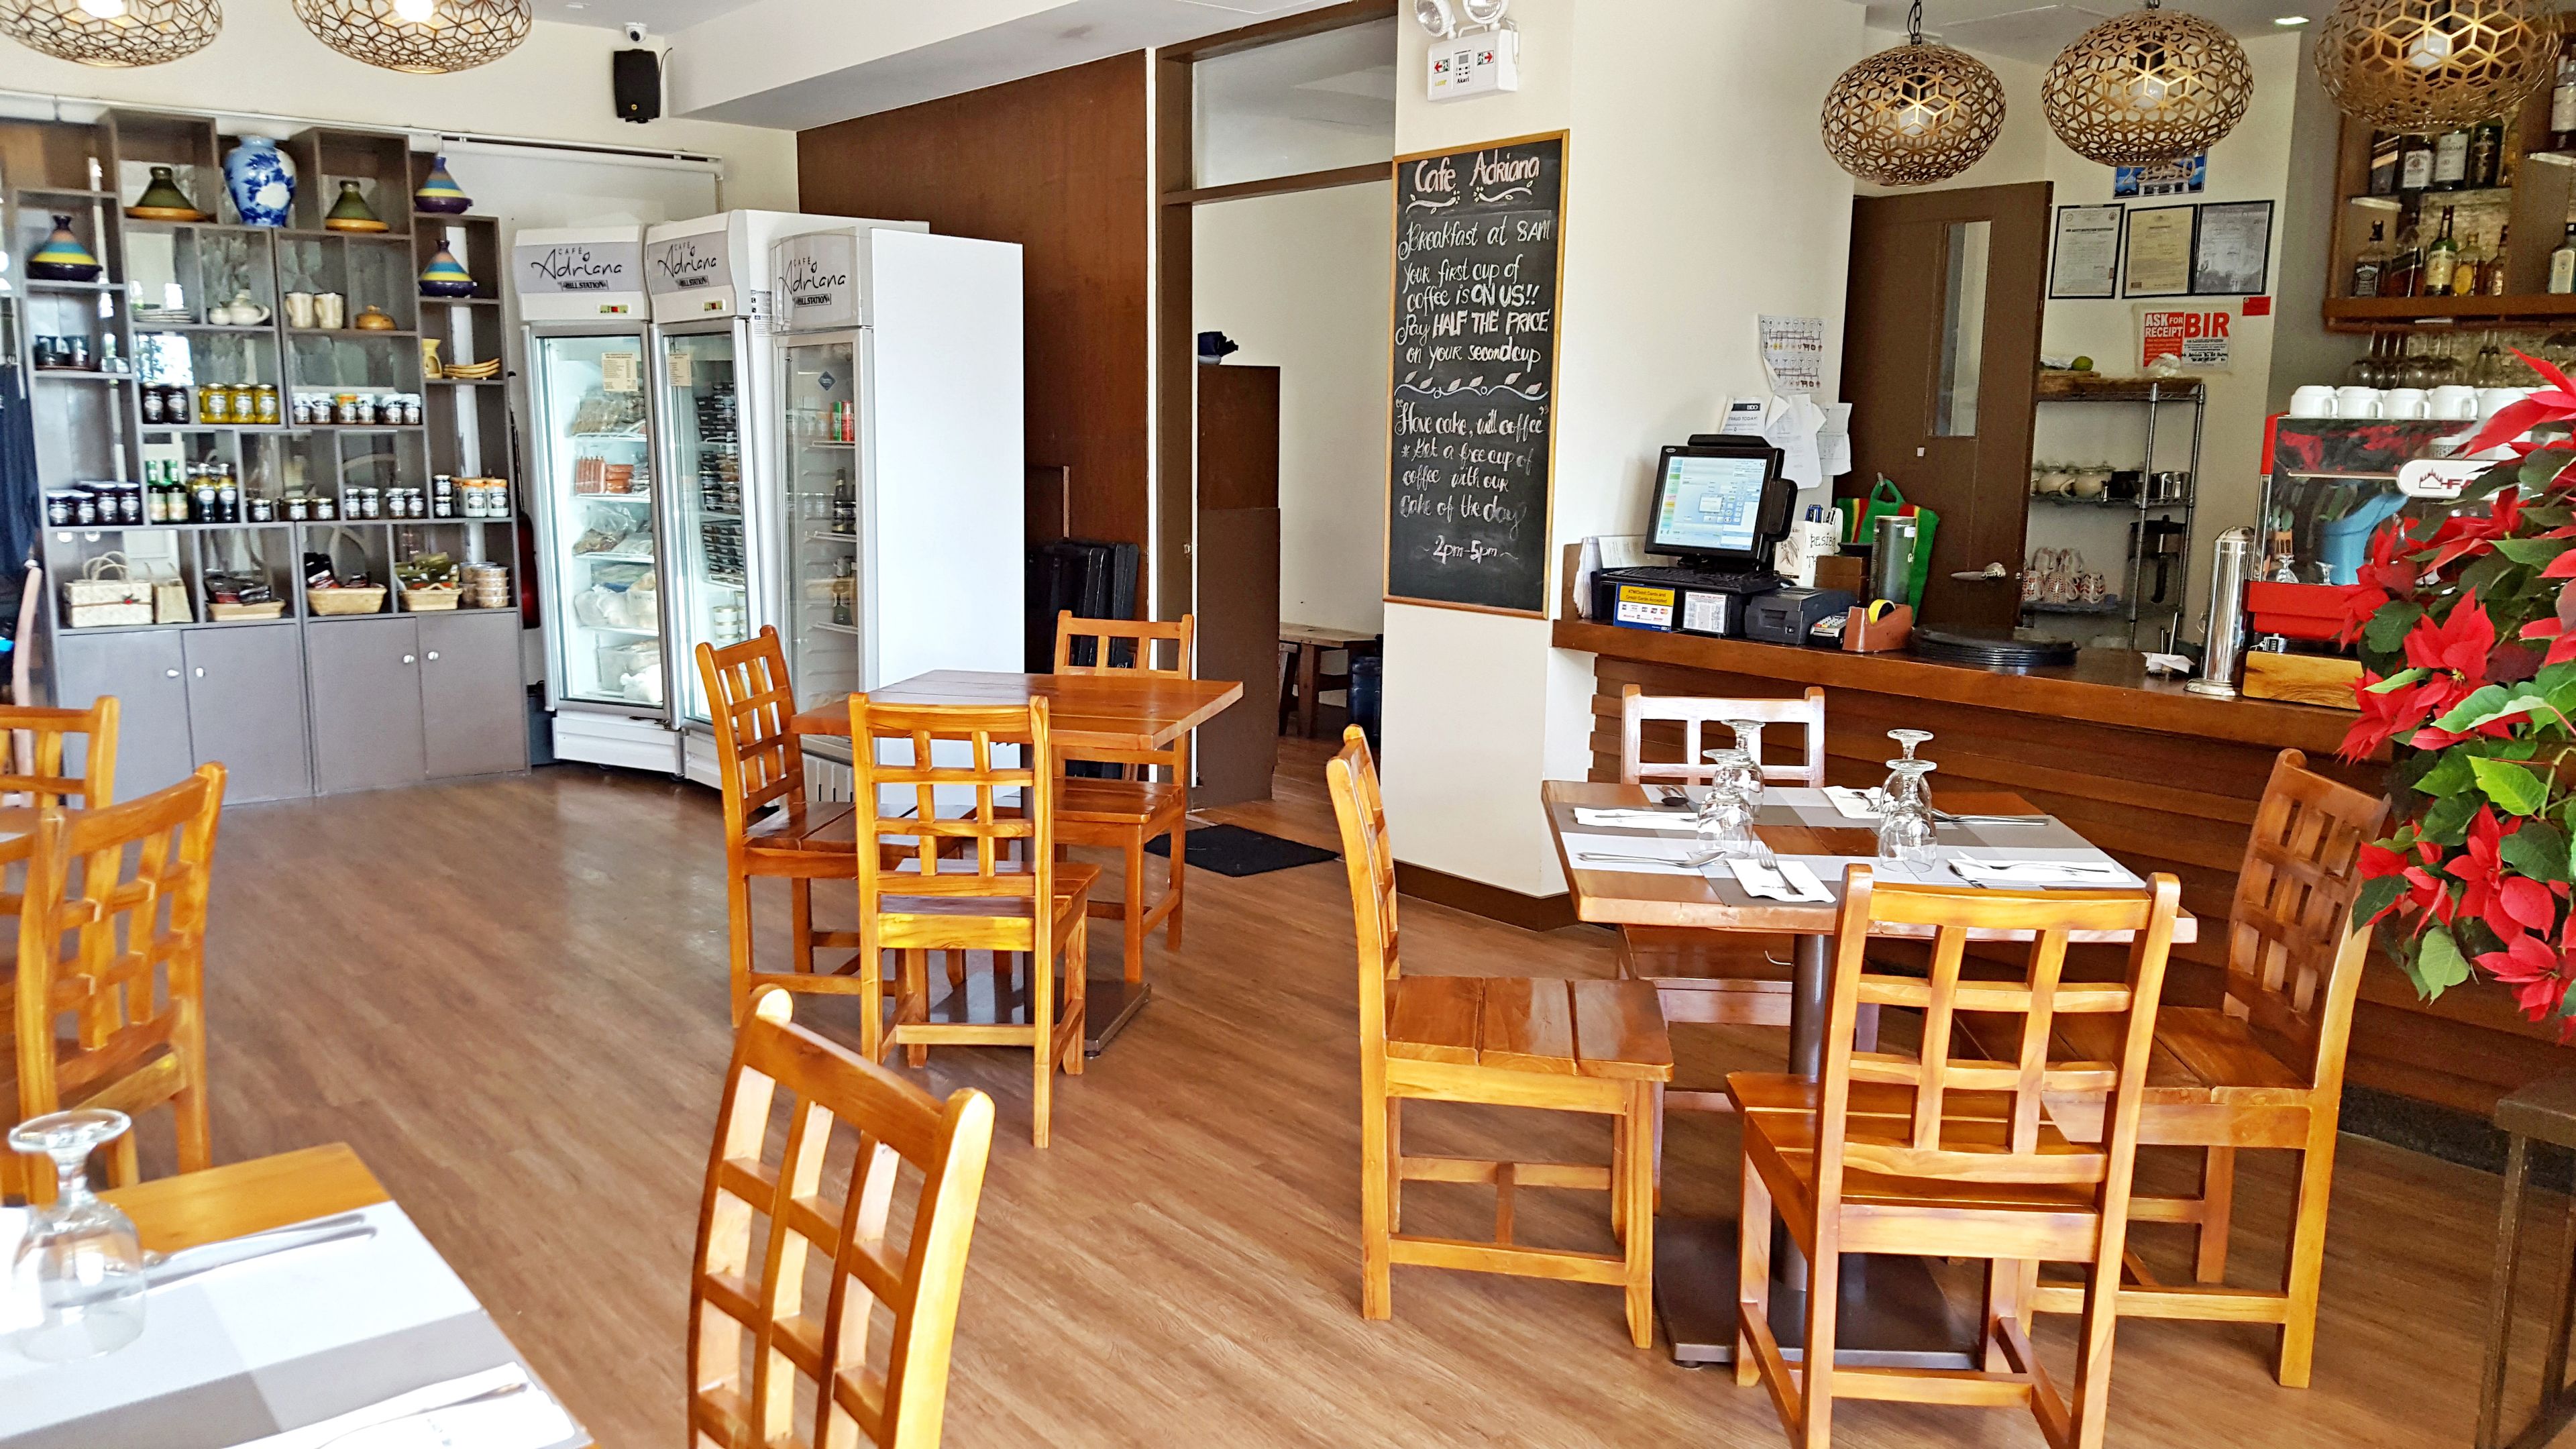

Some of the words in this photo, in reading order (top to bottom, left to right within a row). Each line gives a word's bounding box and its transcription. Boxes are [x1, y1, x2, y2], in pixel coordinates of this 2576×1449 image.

[1414, 156, 1457, 193] Cafe
[1469, 149, 1541, 186] Adriana
[1398, 221, 1479, 261] Breakfast
[1487, 215, 1508, 246] at
[1517, 220, 1551, 242] 8AM
[531, 248, 623, 280] Adriana
[657, 244, 716, 278] Adriana
[778, 259, 847, 295] Adriana
[1472, 262, 1501, 290] cup
[1504, 252, 1524, 284] of
[1407, 285, 1451, 317] coffee
[1455, 284, 1470, 305] is
[1470, 283, 1496, 307] ON
[1499, 283, 1541, 307] US!!
[1395, 313, 1431, 347] Pay
[1432, 310, 1469, 339] HALF
[1471, 309, 1500, 335] THE
[1505, 308, 1552, 336] PRICE
[2145, 327, 2184, 337] RECEIPT
[2146, 313, 2169, 327] ASK
[2169, 317, 2184, 325] FOR
[2184, 312, 2230, 338] BIR
[1406, 344, 1423, 364] on
[1443, 445, 1454, 460] a
[1459, 443, 1487, 470] free
[1488, 450, 1515, 472] cup
[1516, 447, 1535, 476] of
[1403, 464, 1441, 492] coffee
[1451, 466, 1480, 489] with
[1437, 494, 1454, 523] of
[1460, 494, 1483, 518] the
[1483, 495, 1527, 541] day
